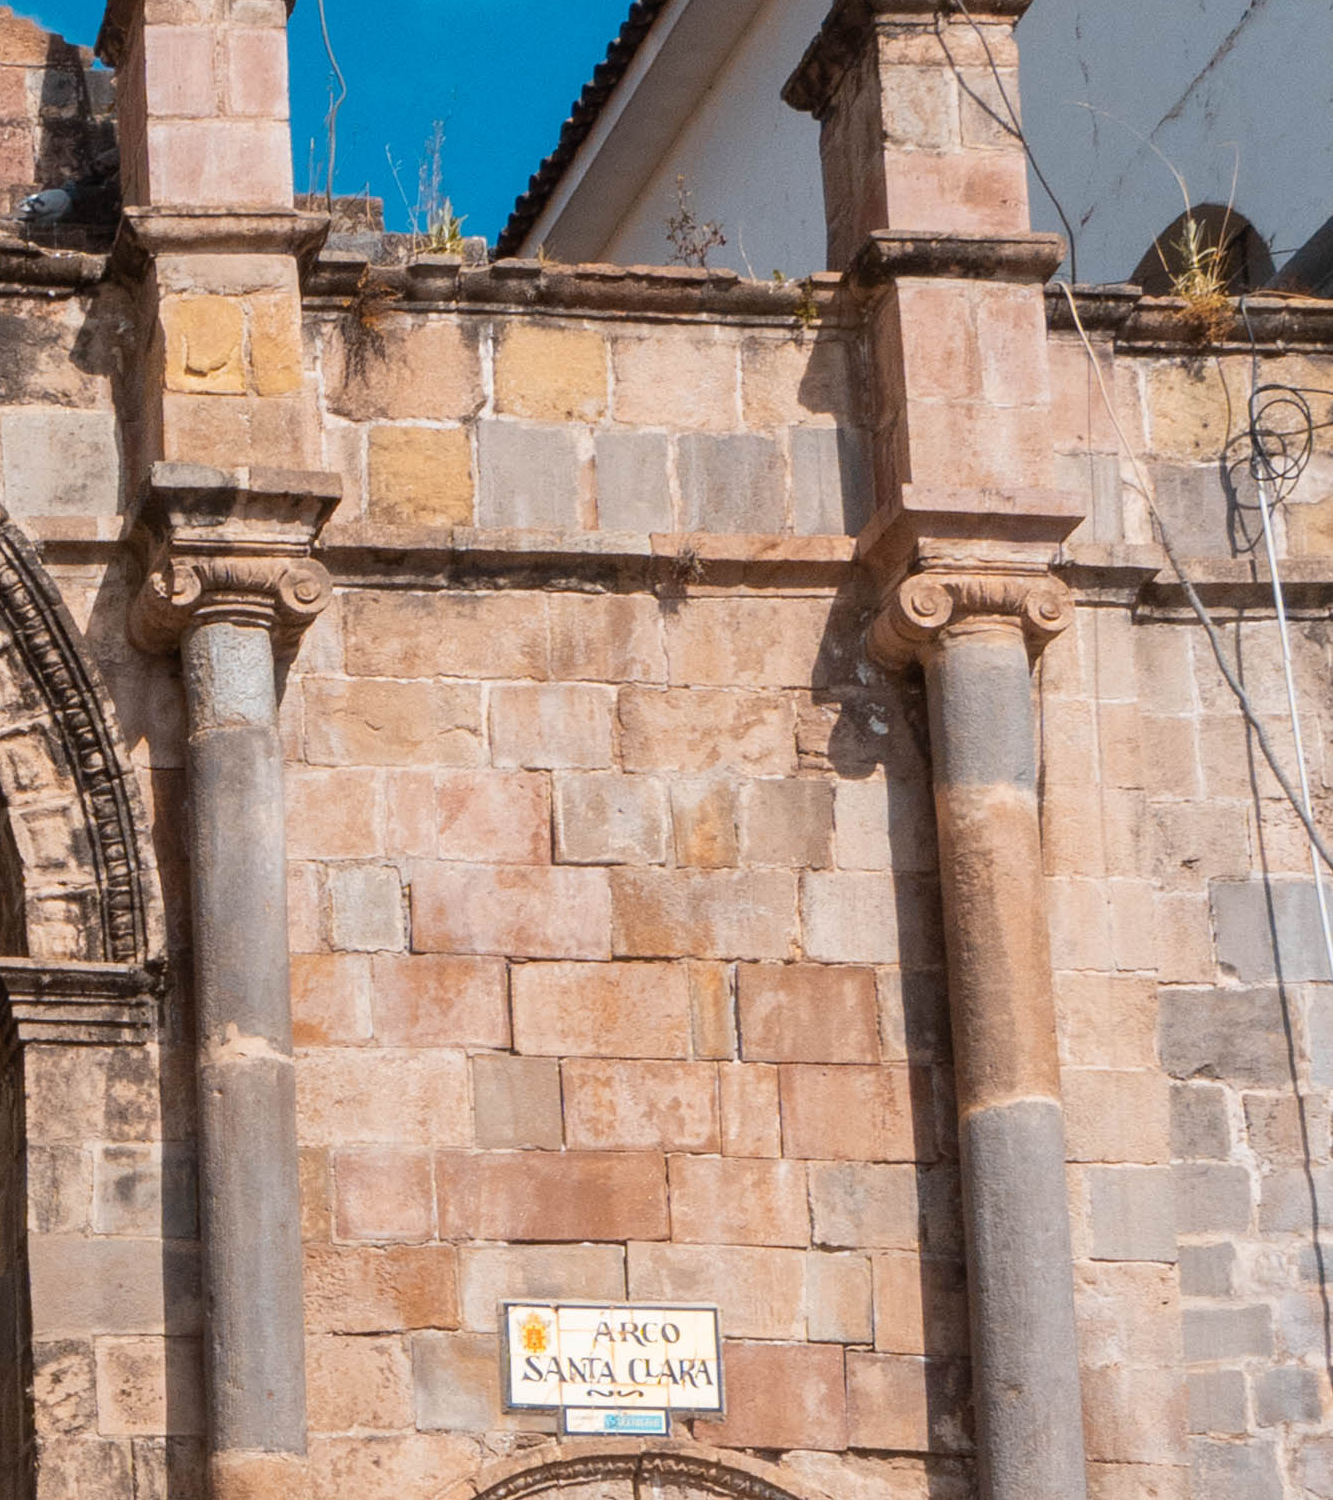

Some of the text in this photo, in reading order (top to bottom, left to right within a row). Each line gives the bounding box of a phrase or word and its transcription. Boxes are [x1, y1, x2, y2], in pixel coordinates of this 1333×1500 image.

[593, 1321, 681, 1348] ARCO
[521, 1356, 714, 1389] SANTA CLARA
